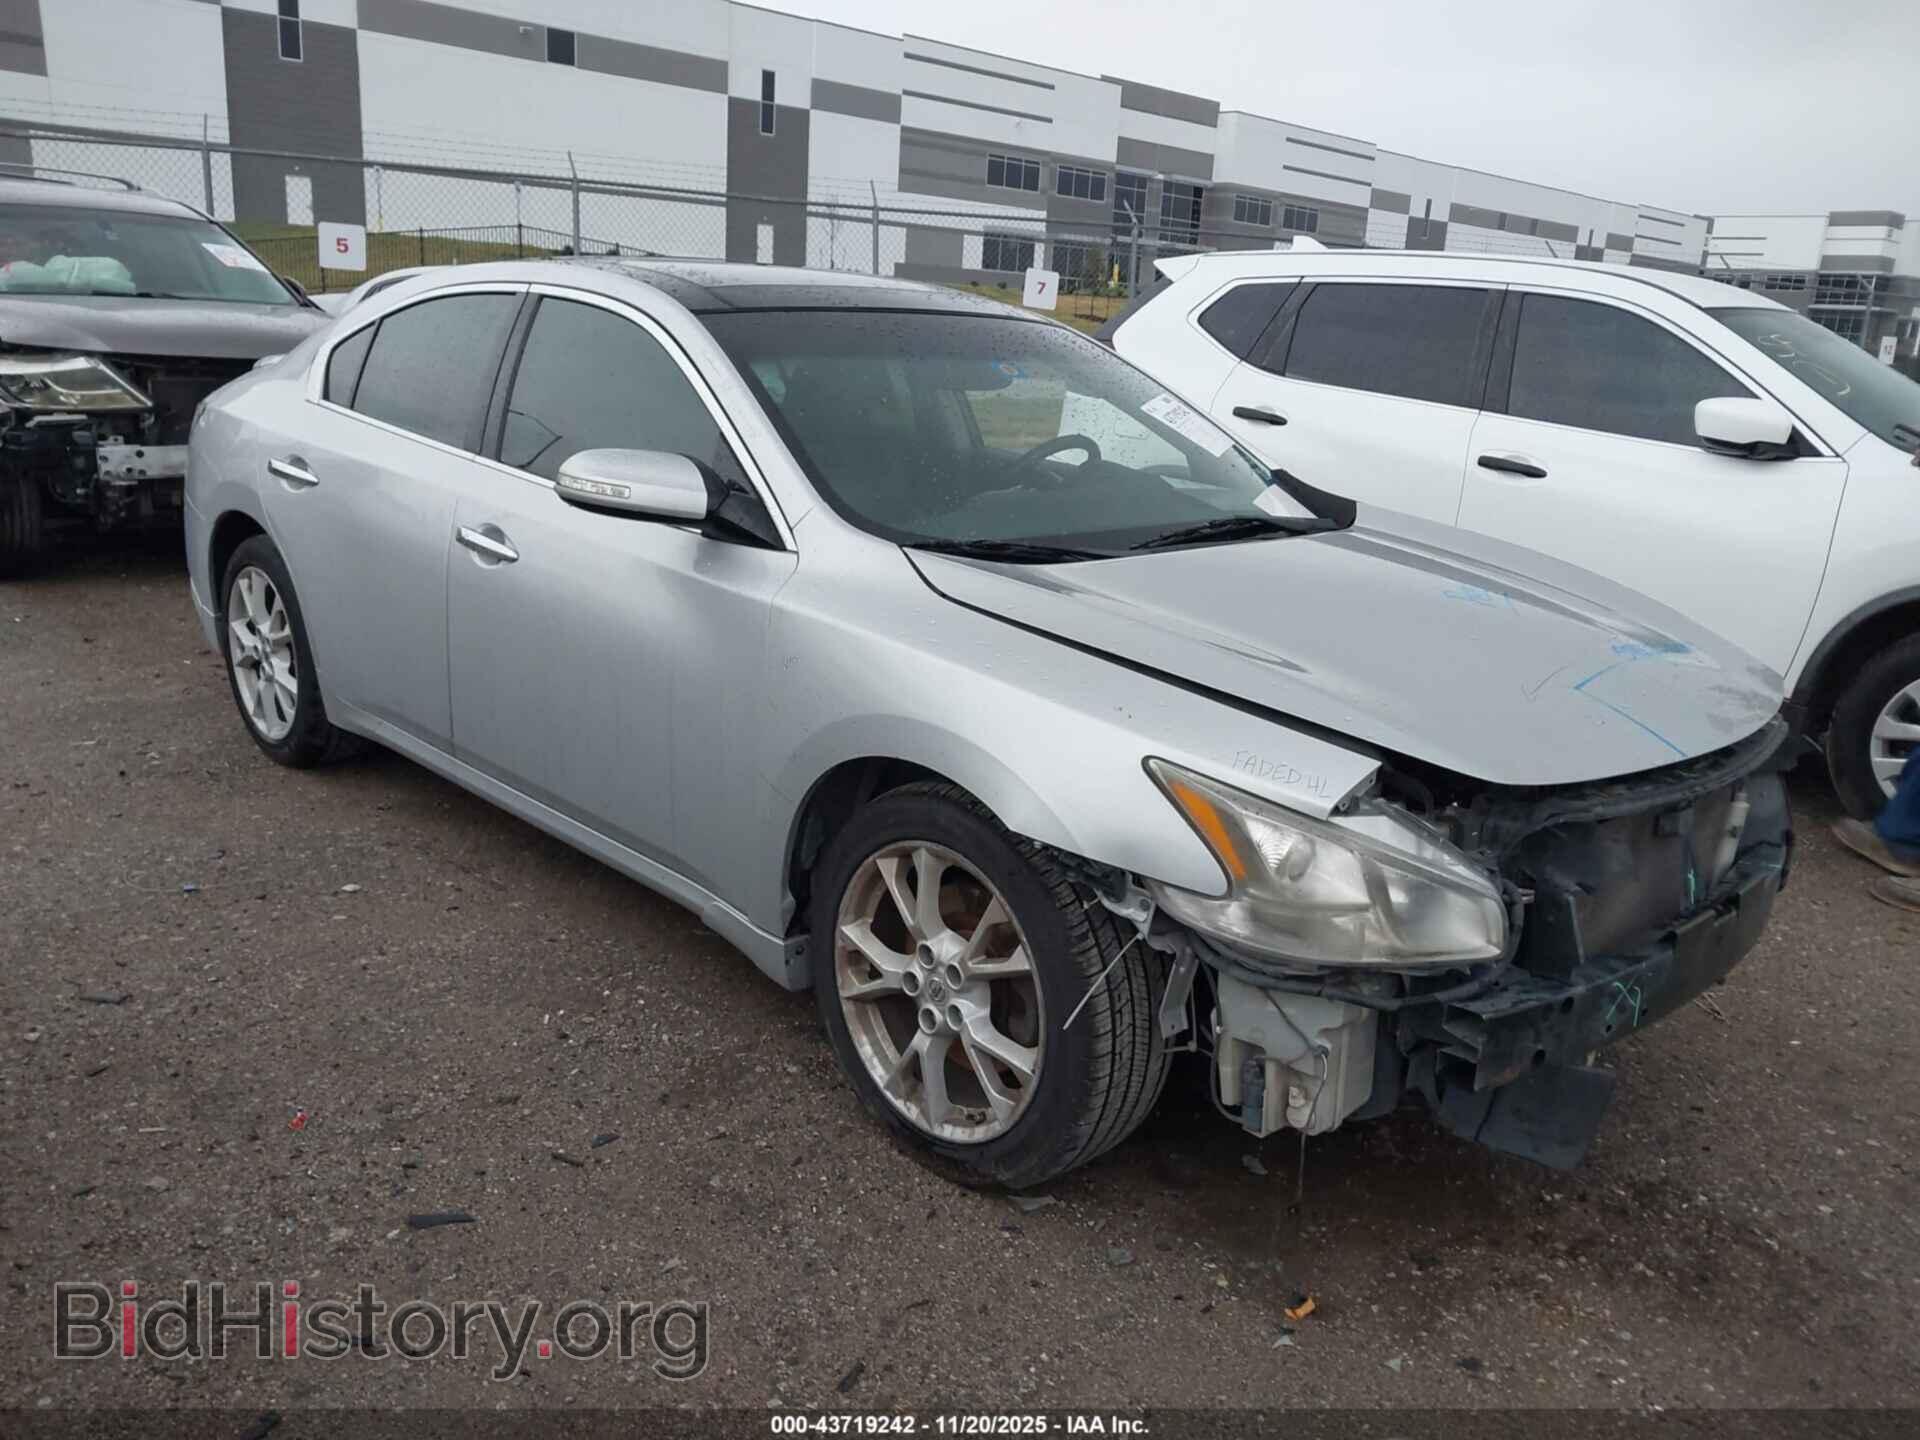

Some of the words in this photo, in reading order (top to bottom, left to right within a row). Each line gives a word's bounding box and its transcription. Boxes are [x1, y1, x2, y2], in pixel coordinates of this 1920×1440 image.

[336, 237, 349, 254] 5
[1037, 281, 1046, 295] 7
[1231, 750, 1303, 785] FADED
